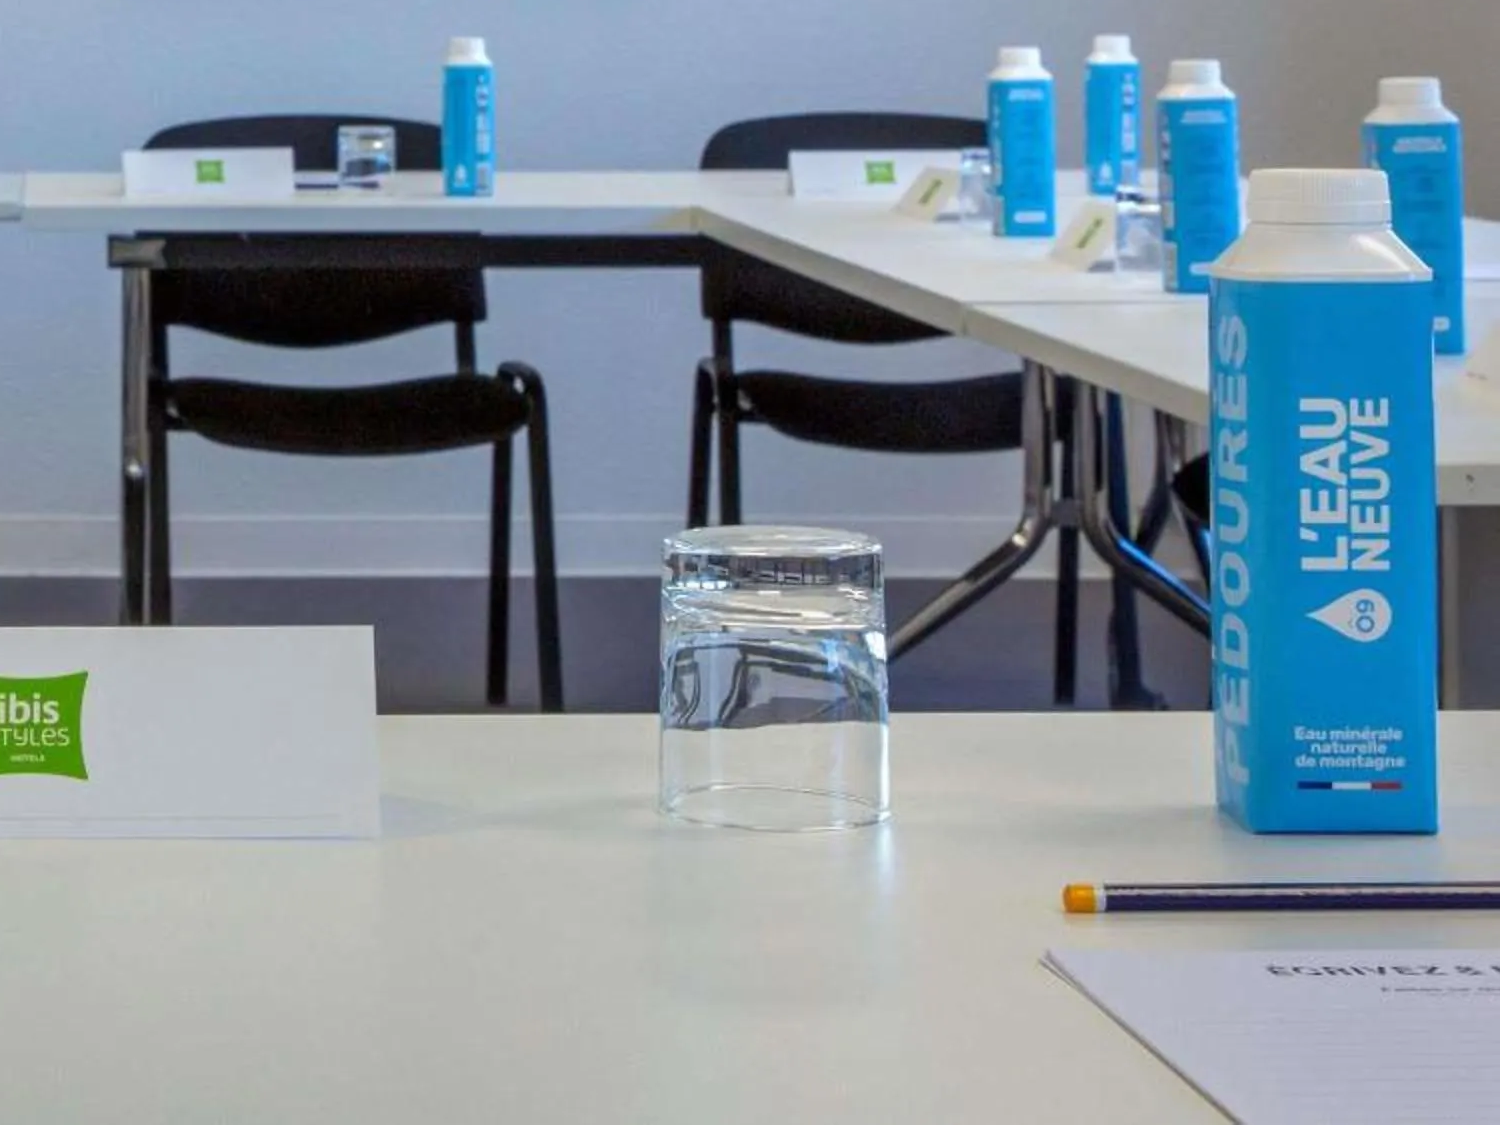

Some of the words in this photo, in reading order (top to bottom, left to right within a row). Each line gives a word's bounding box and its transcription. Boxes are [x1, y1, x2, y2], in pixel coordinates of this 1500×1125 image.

[1299, 398, 1348, 571] L'EAU
[1349, 397, 1391, 571] NEUVE
[1294, 726, 1326, 740] Eau
[1329, 726, 1404, 741] minérale
[1310, 740, 1388, 754] naturelle
[1295, 754, 1316, 767] de
[1319, 755, 1407, 772] montagne
